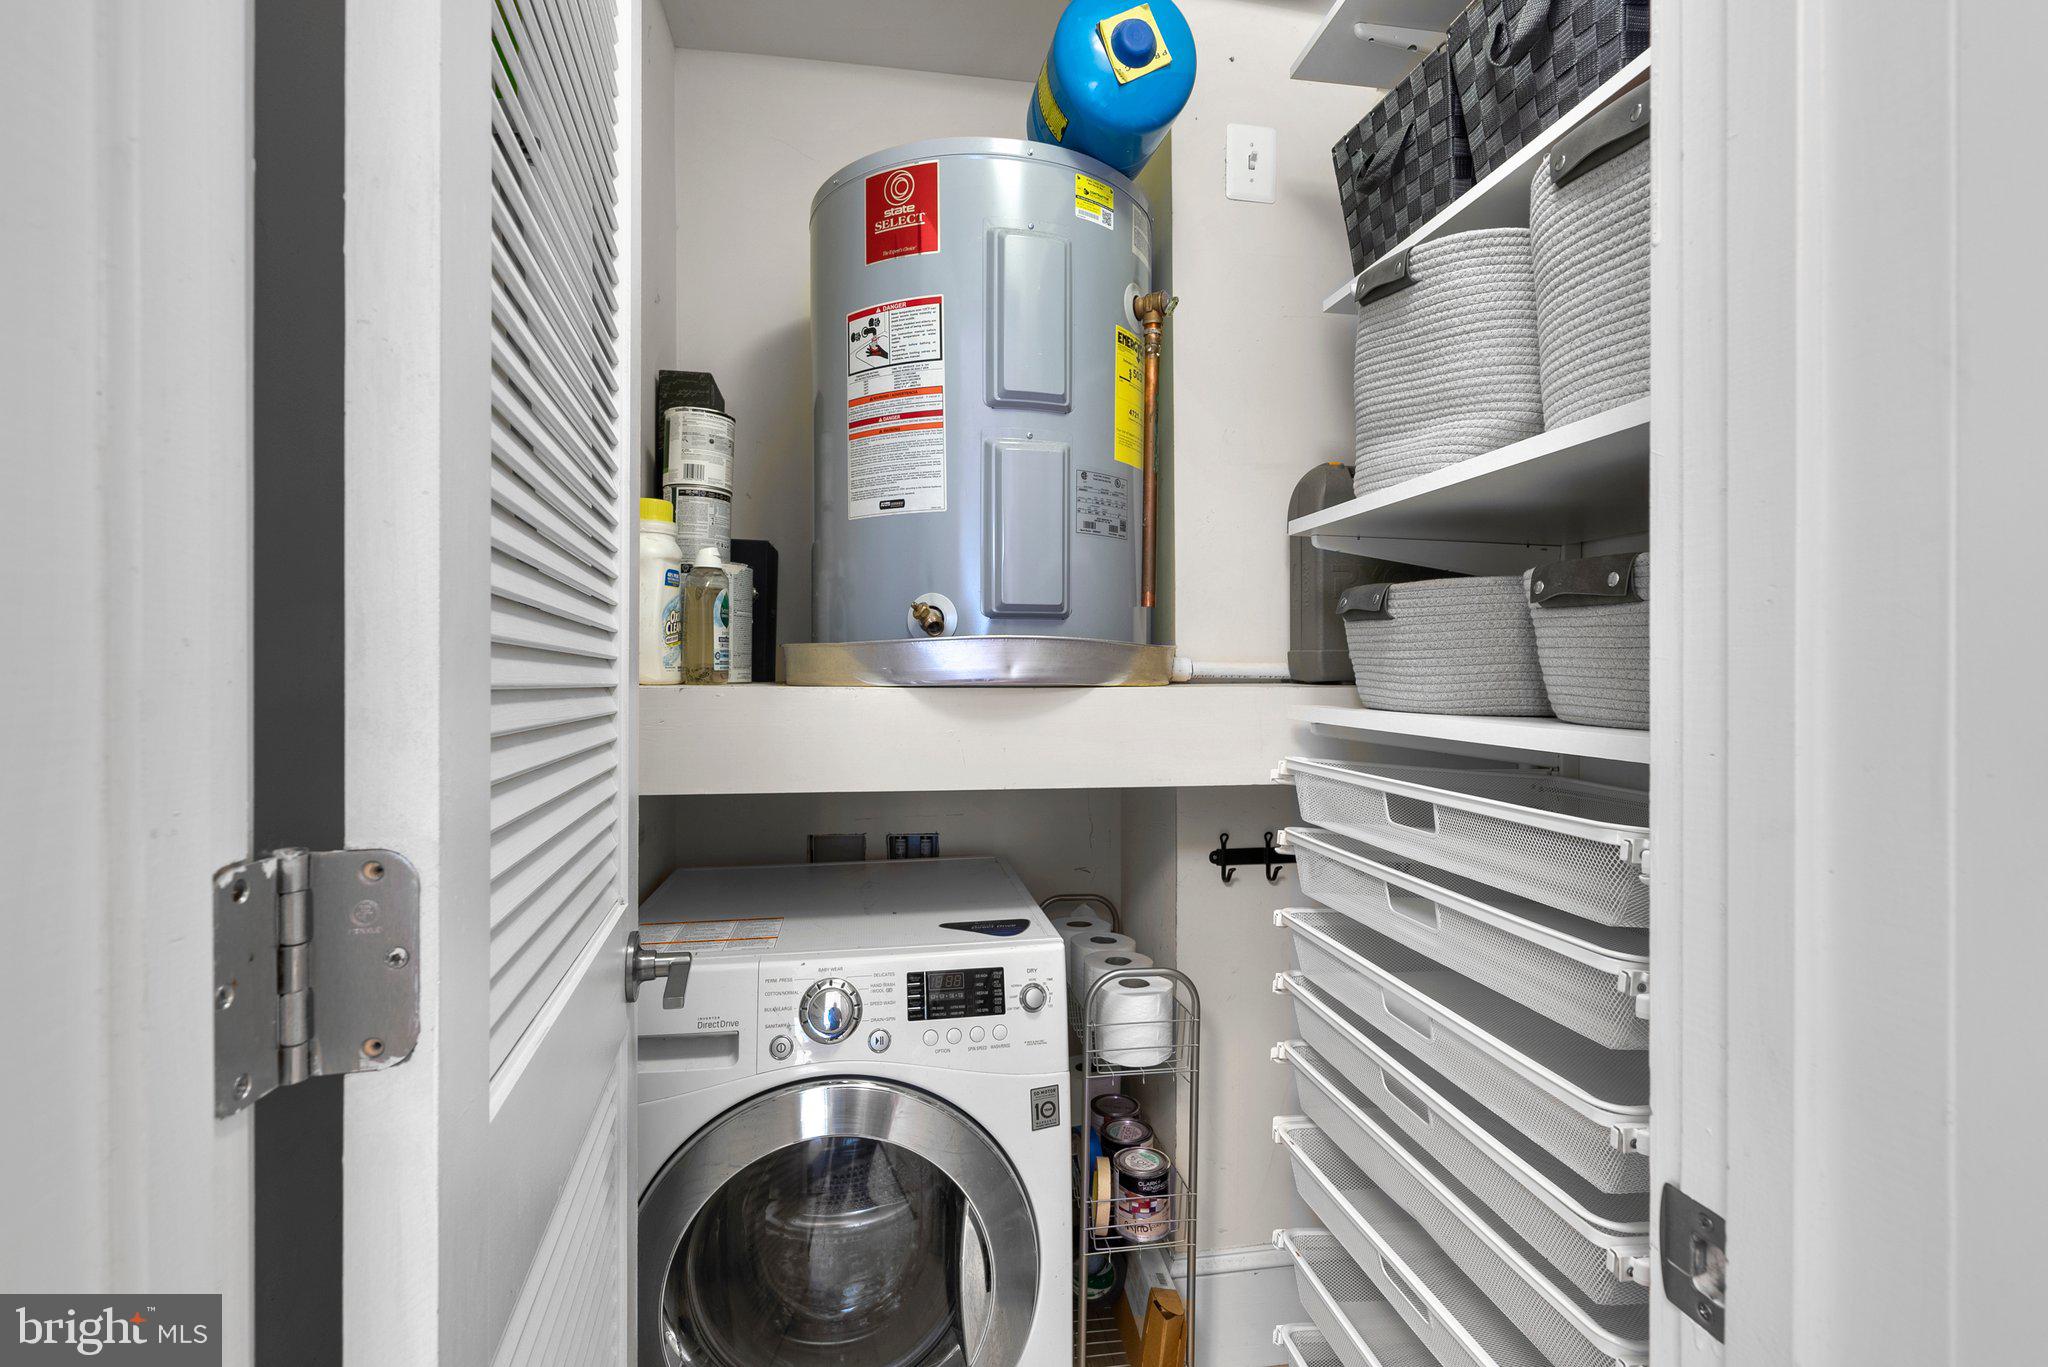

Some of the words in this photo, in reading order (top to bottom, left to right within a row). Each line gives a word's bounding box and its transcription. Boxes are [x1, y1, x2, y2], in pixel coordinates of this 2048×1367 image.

[884, 204, 916, 218] state
[874, 212, 926, 232] SELECT
[882, 302, 907, 312] DANGER
[1035, 1101, 1056, 1120] 10
